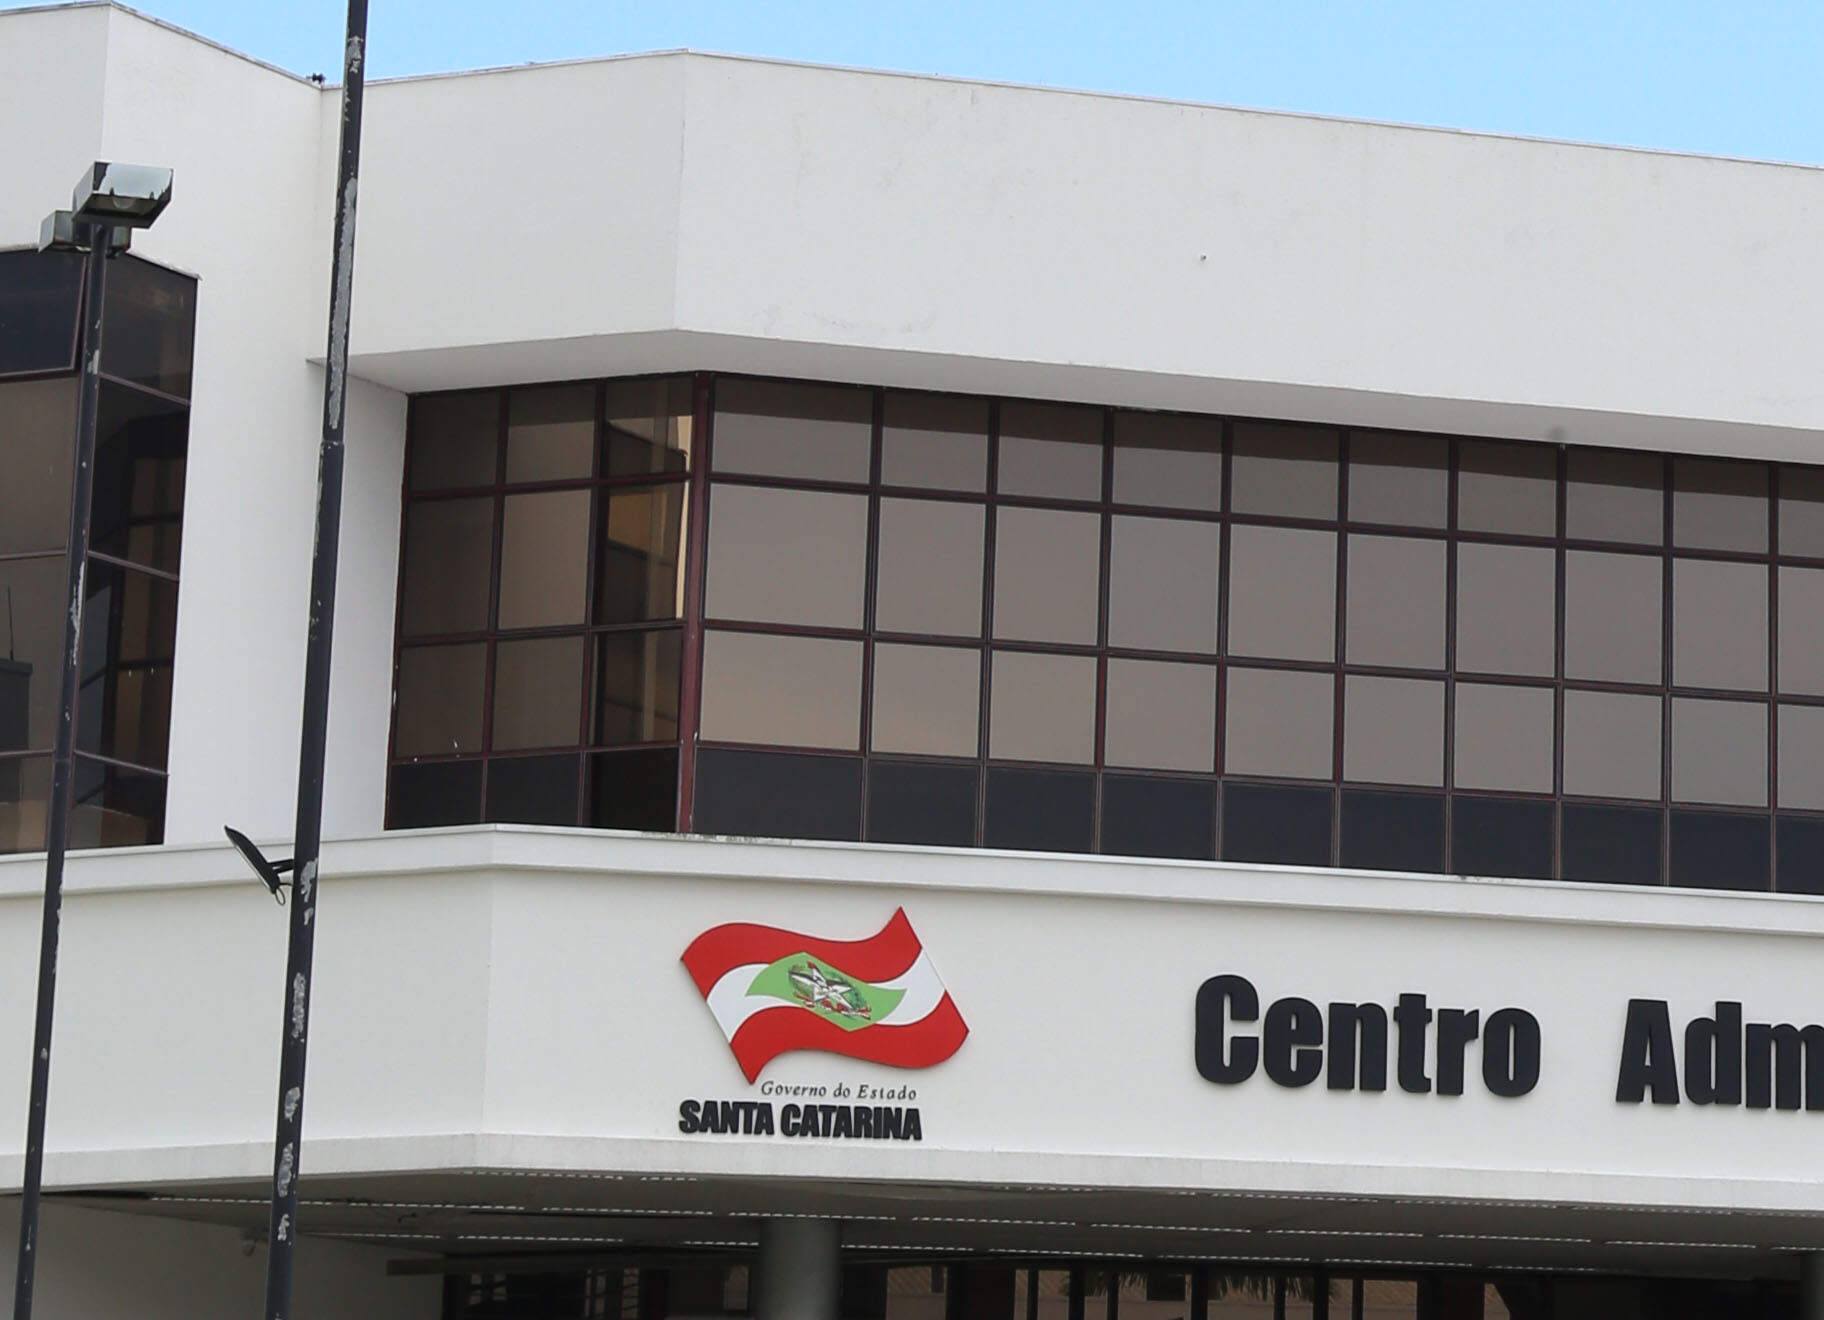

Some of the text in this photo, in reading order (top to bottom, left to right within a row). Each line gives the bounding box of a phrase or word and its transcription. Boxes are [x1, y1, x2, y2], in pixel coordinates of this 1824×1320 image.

[1194, 973, 1541, 1097] Centro
[760, 1080, 918, 1101] Governo do Estado
[678, 1099, 923, 1141] SANTA CATARINA
